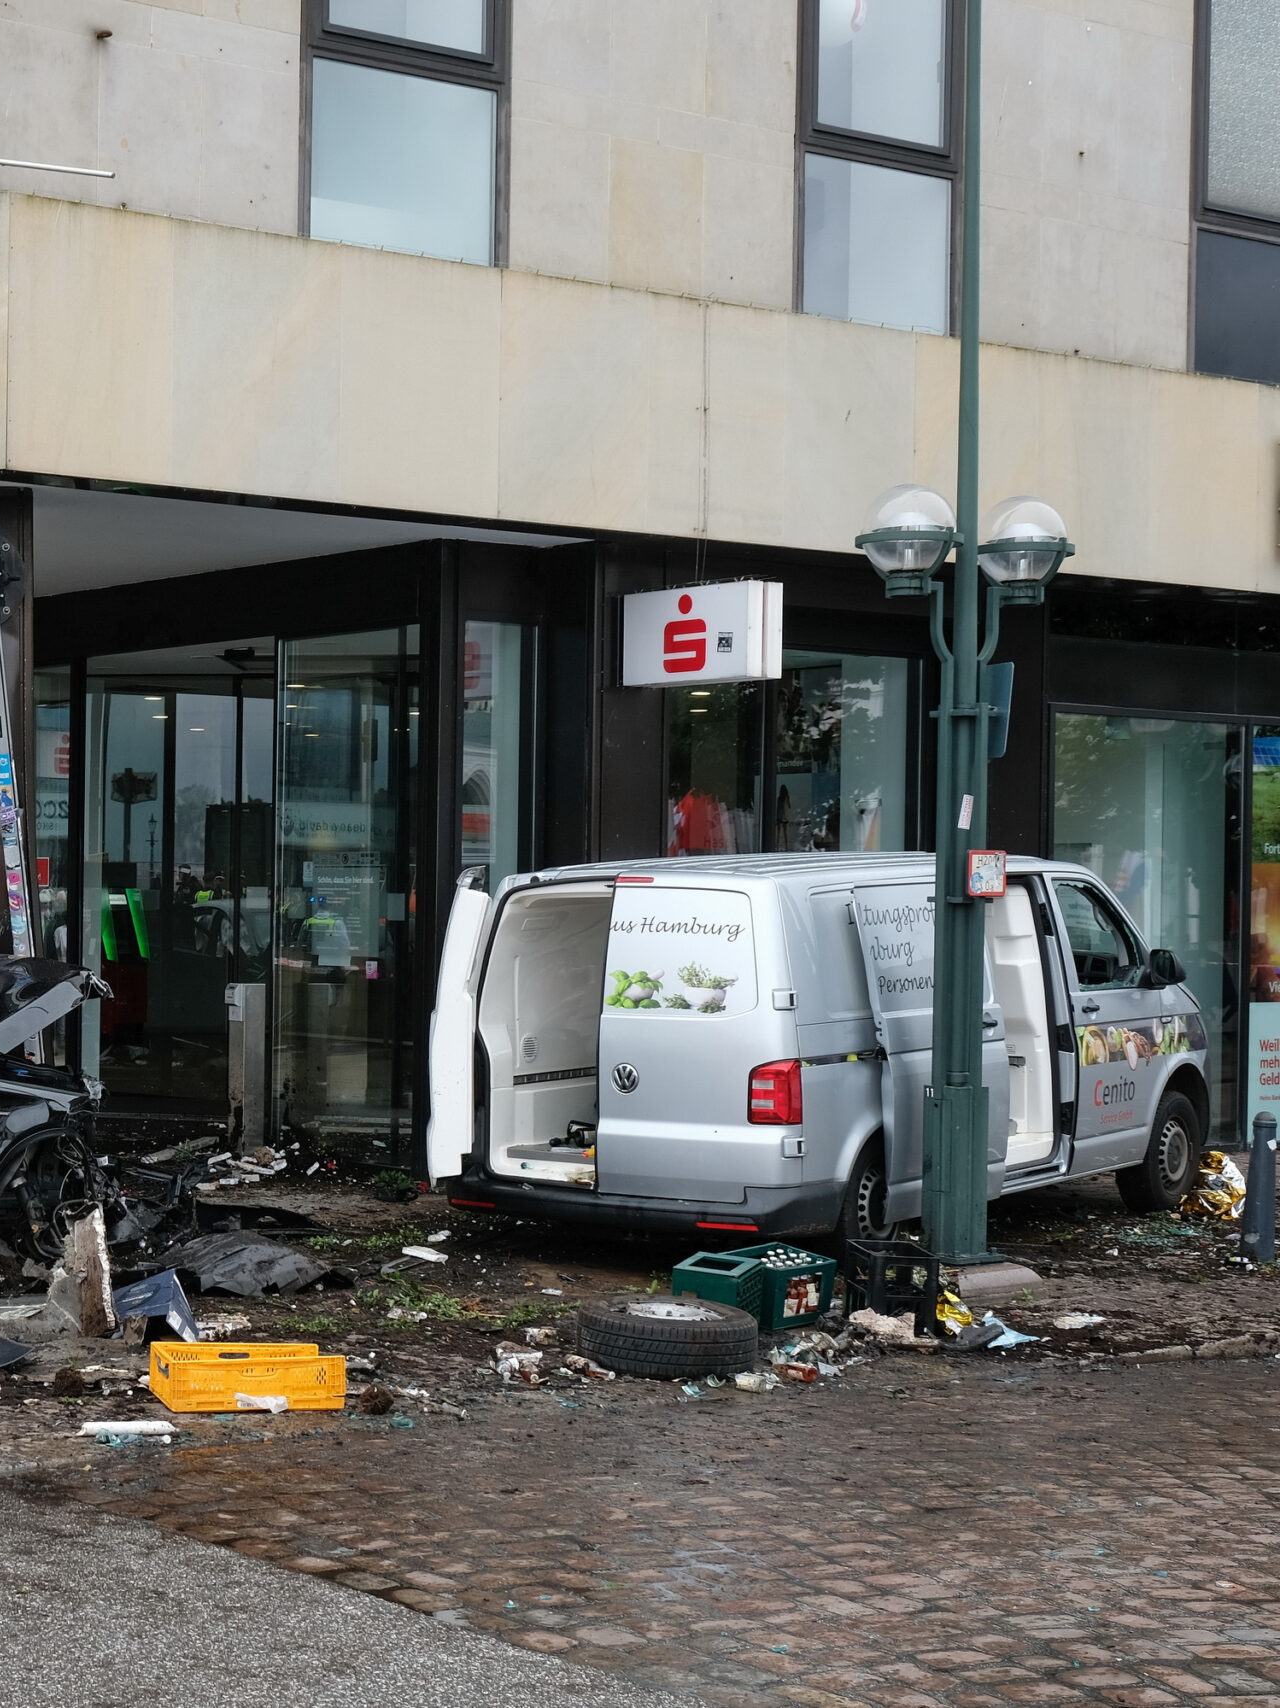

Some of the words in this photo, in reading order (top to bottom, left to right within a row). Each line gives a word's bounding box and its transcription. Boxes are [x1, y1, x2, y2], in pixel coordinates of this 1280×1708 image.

[640, 916, 746, 943] Hamburg
[878, 975, 934, 995] Personen
[1093, 1074, 1136, 1107] Cenito
